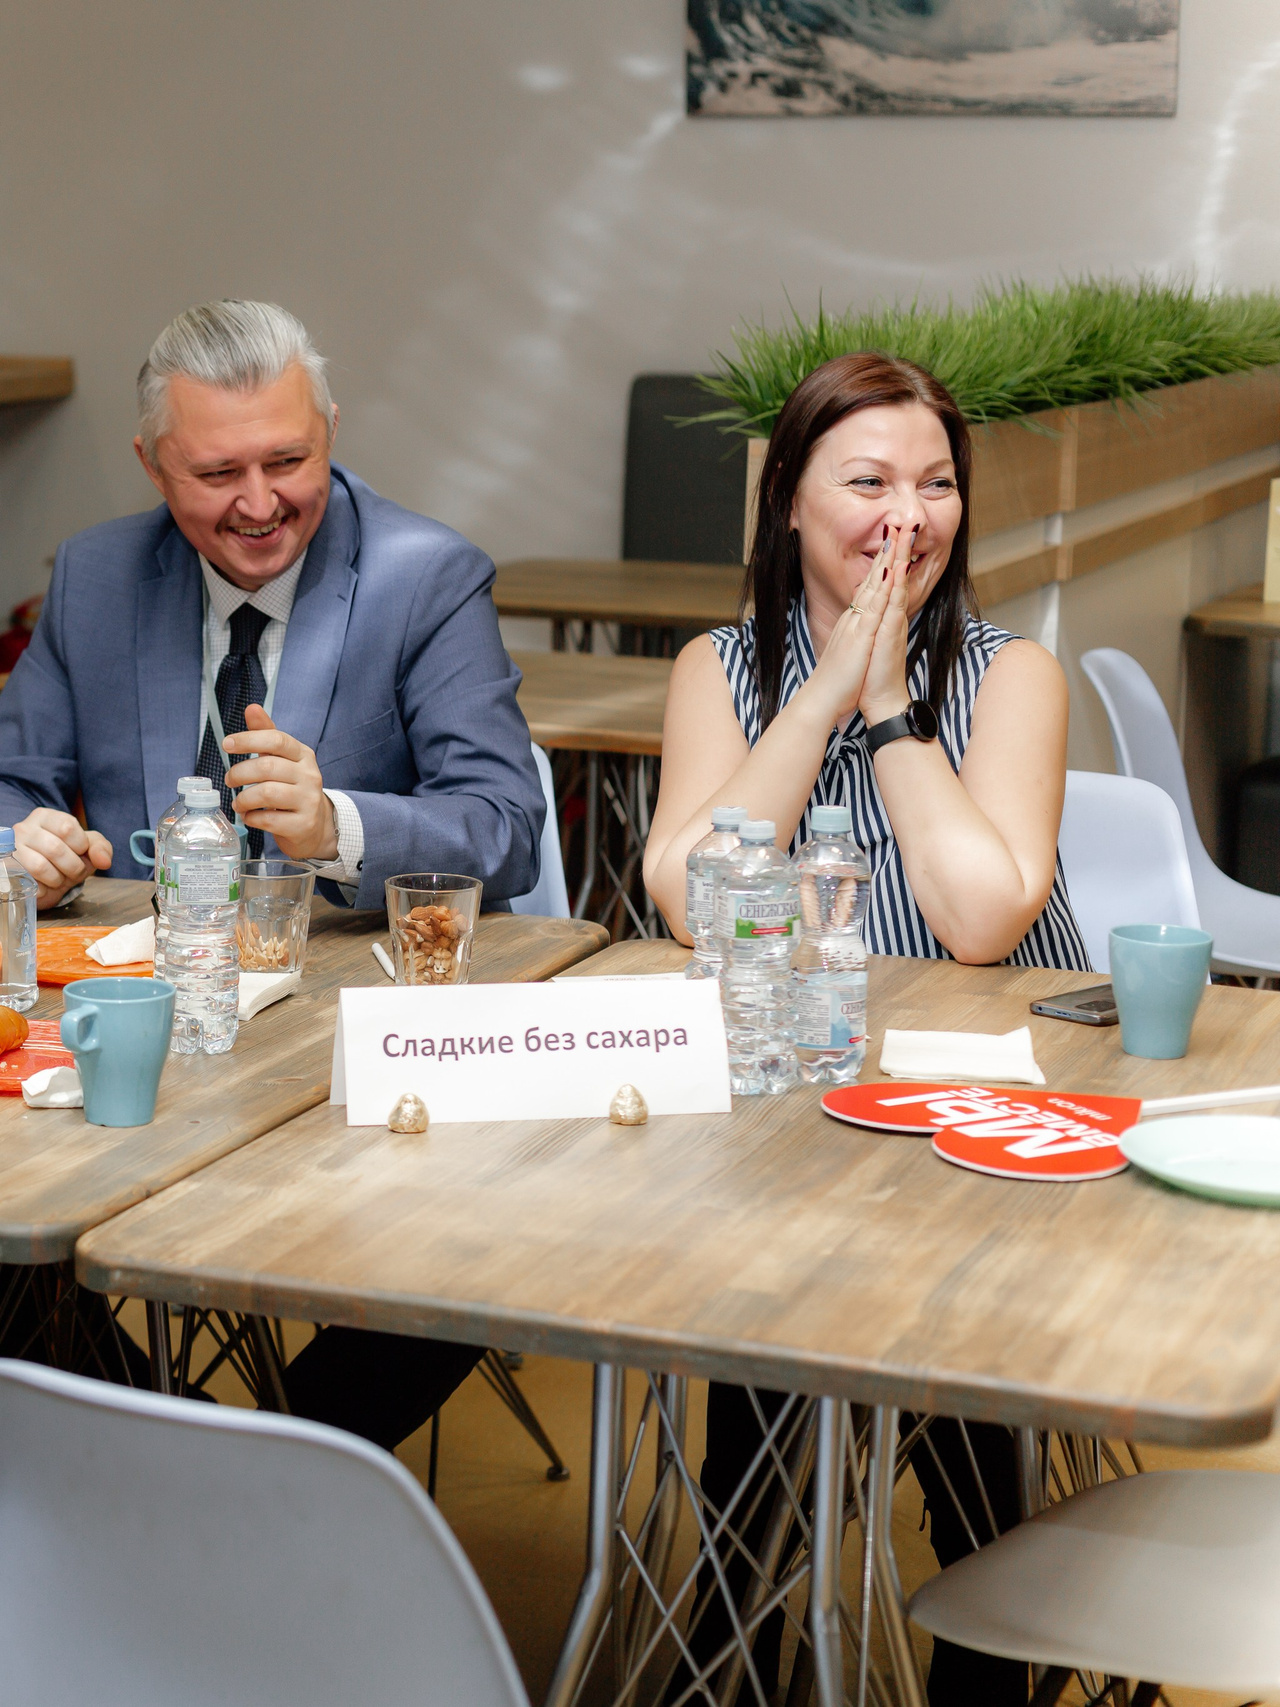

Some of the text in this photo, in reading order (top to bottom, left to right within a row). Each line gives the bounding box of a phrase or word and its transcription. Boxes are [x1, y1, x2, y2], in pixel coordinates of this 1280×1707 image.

[382, 1027, 688, 1061] Сладкие без сахара
[875, 1091, 1096, 1159] МЫ
[949, 1087, 1121, 1148] ВМЕСТЕ
[1047, 1098, 1113, 1121] mikron
